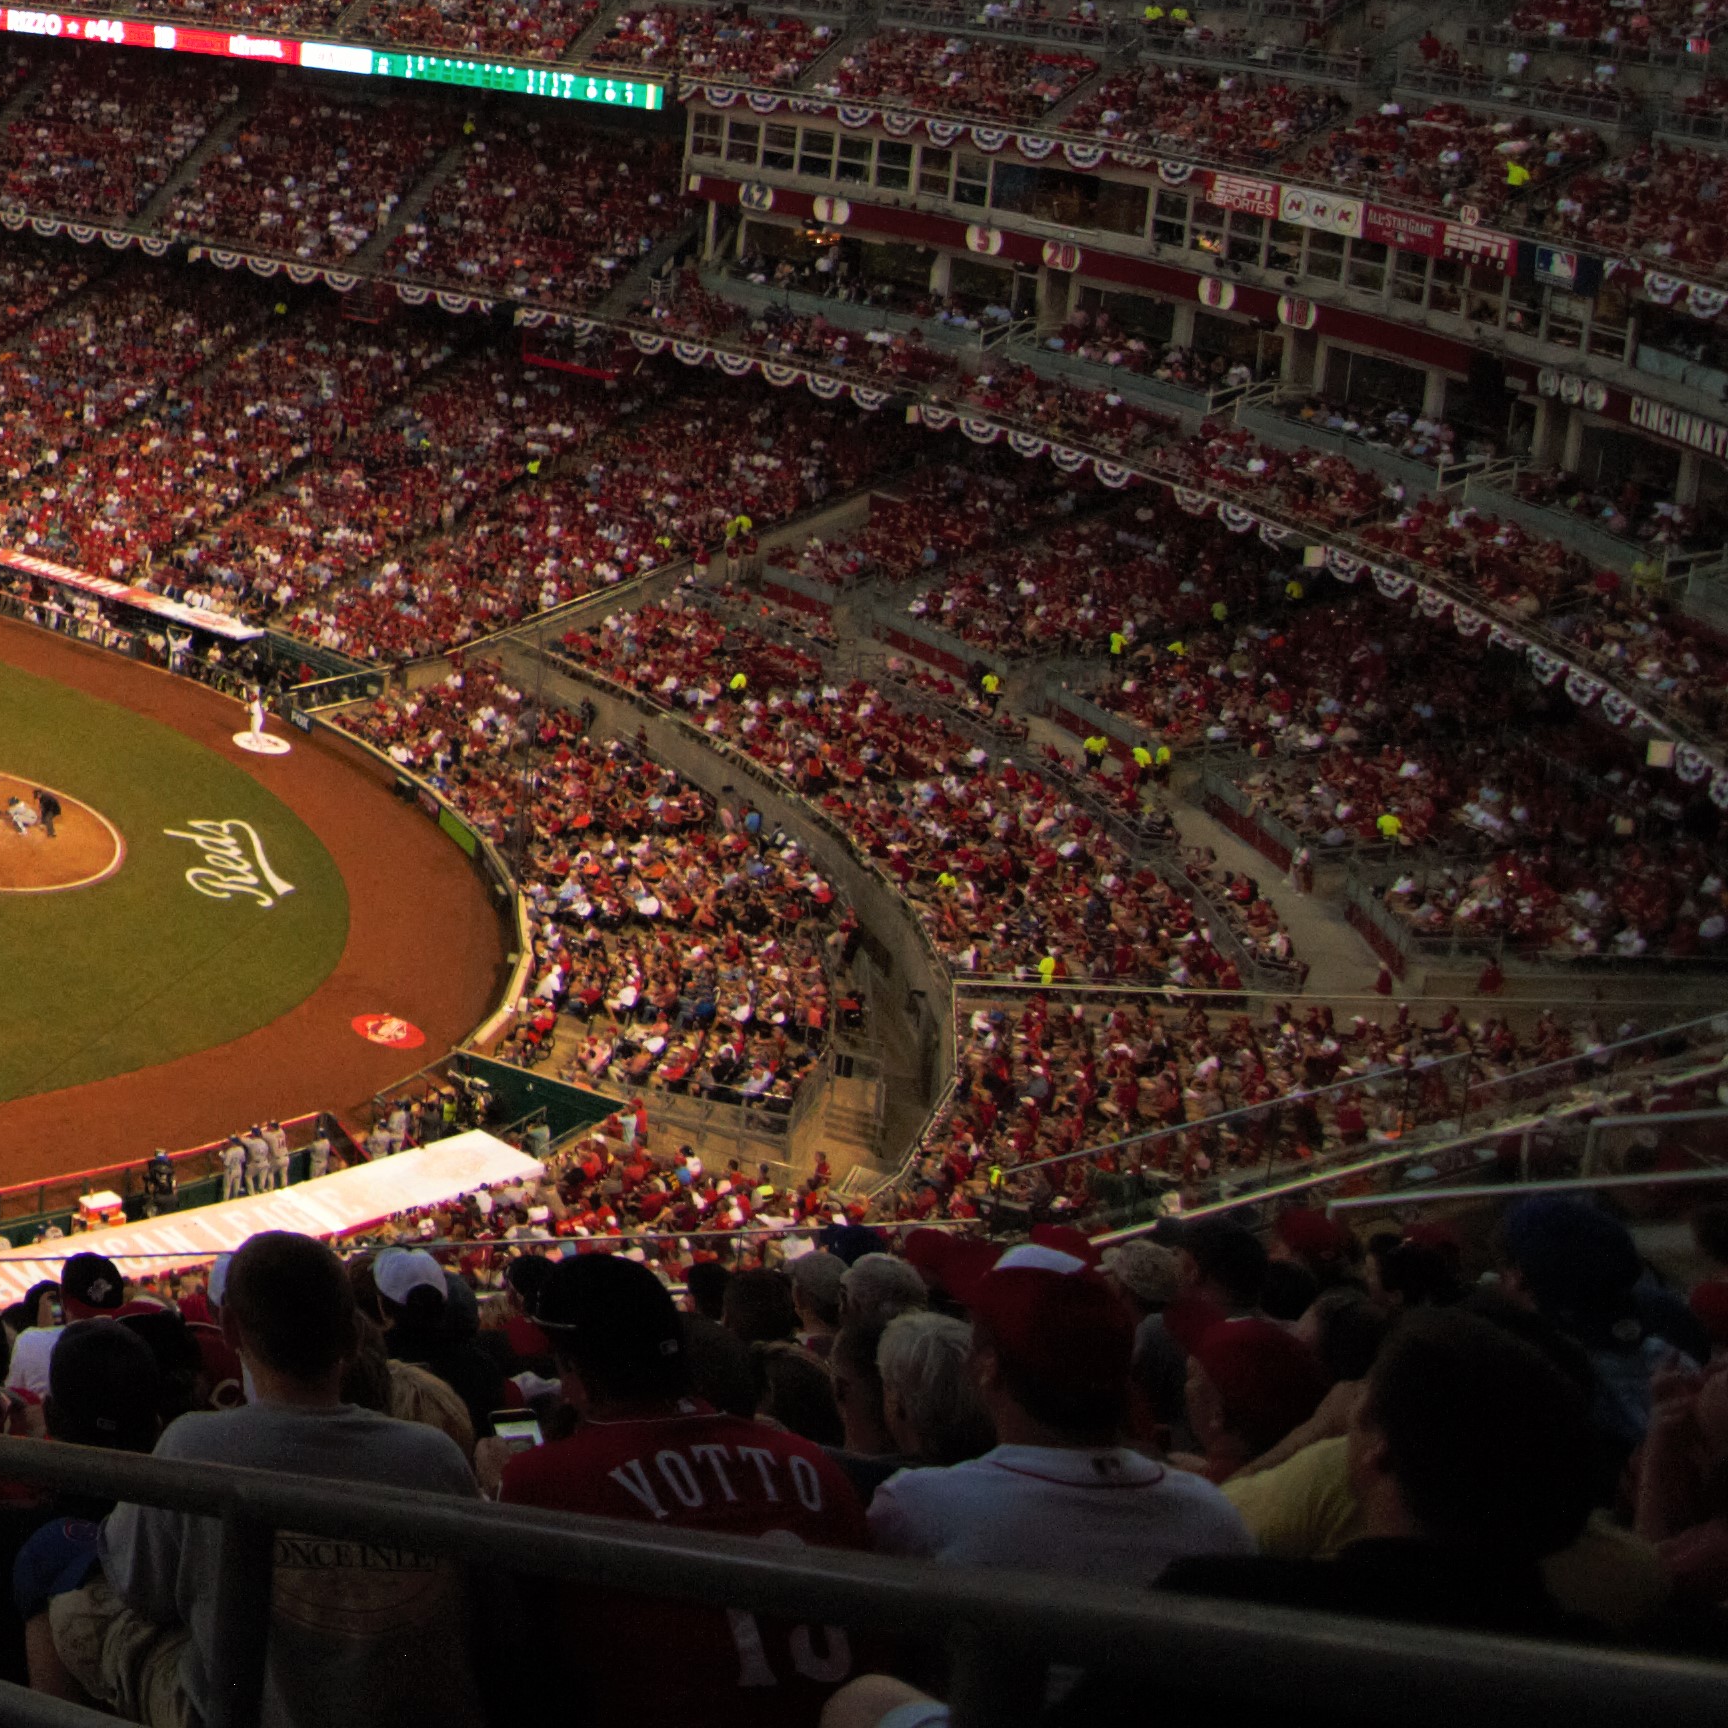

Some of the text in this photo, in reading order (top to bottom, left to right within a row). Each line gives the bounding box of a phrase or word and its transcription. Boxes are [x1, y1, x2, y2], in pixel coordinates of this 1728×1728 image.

[6, 9, 62, 36] RIZZO
[84, 19, 125, 44] #44
[743, 183, 770, 209] 42
[1213, 172, 1278, 202] ESPN
[825, 198, 836, 221] 1
[1205, 189, 1274, 218] DEPORTES
[1462, 206, 1477, 224] 14
[977, 227, 990, 251] 5
[1443, 224, 1511, 260] ESPN
[1047, 243, 1077, 269] 20
[1443, 249, 1506, 271] RADIO
[1629, 394, 1728, 461] CINCINNAT
[163, 818, 295, 908] Reds
[607, 1442, 823, 1520] VOTTO
